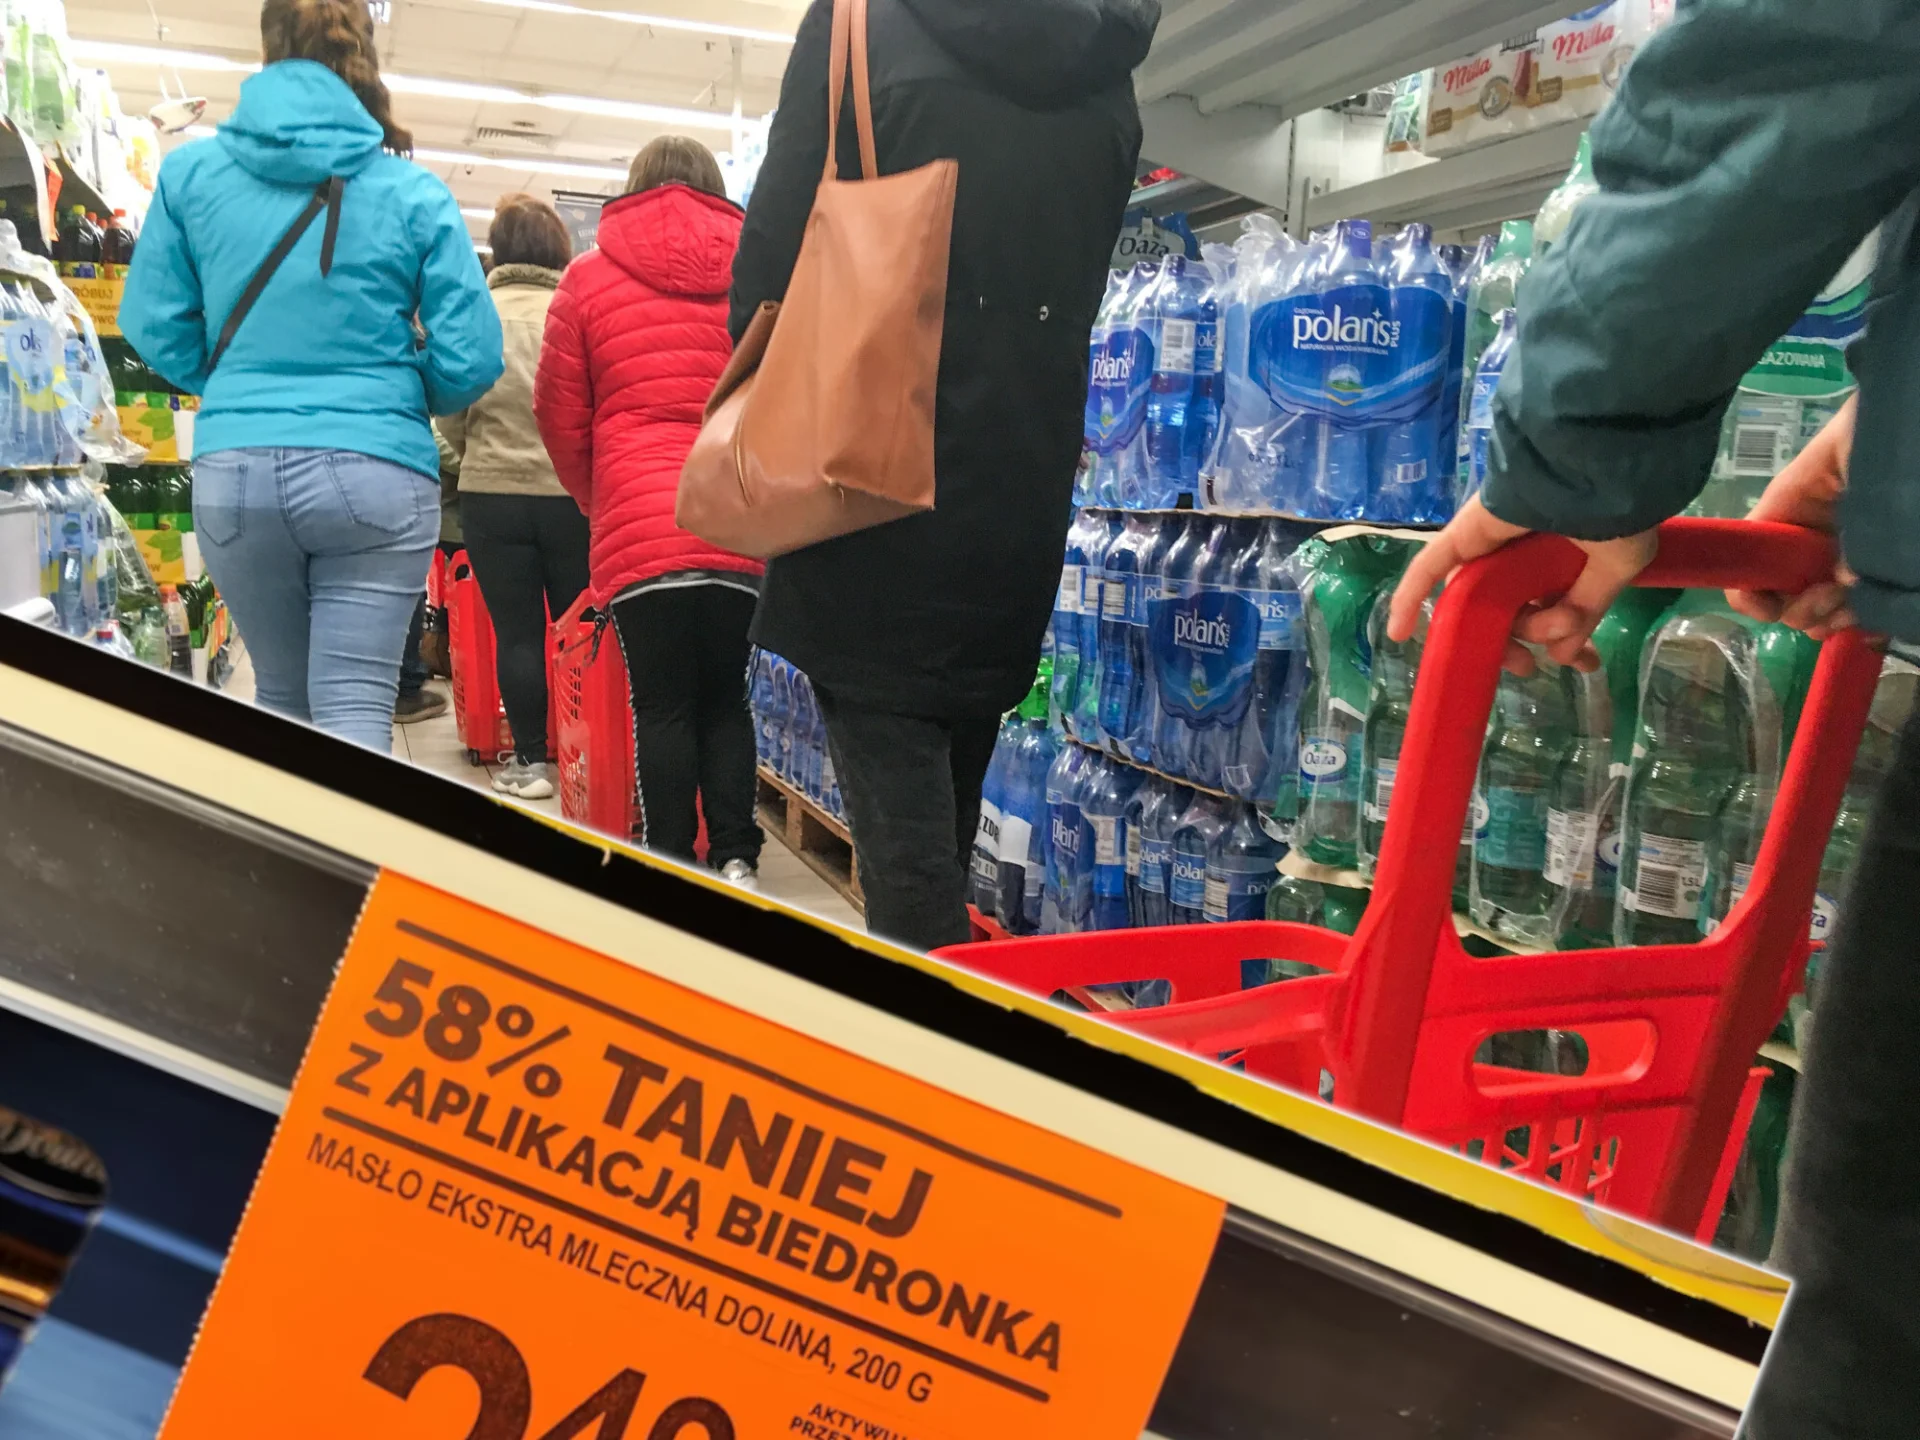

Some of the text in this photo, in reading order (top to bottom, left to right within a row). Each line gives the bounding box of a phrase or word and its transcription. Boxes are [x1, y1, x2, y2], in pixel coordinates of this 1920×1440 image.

[1552, 21, 1615, 61] Milla
[1443, 57, 1492, 93] Milla
[1118, 237, 1170, 258] Oaza
[1293, 304, 1402, 349] polaris PLUS
[1174, 608, 1226, 646] polaris
[363, 957, 935, 1239] 58% TANIEJ
[334, 1042, 1062, 1372] Z APLIKACJĄ BIEDRONKA
[306, 1132, 935, 1403] MASŁO EKSTRA MLECZNA DOLINA, 200 G
